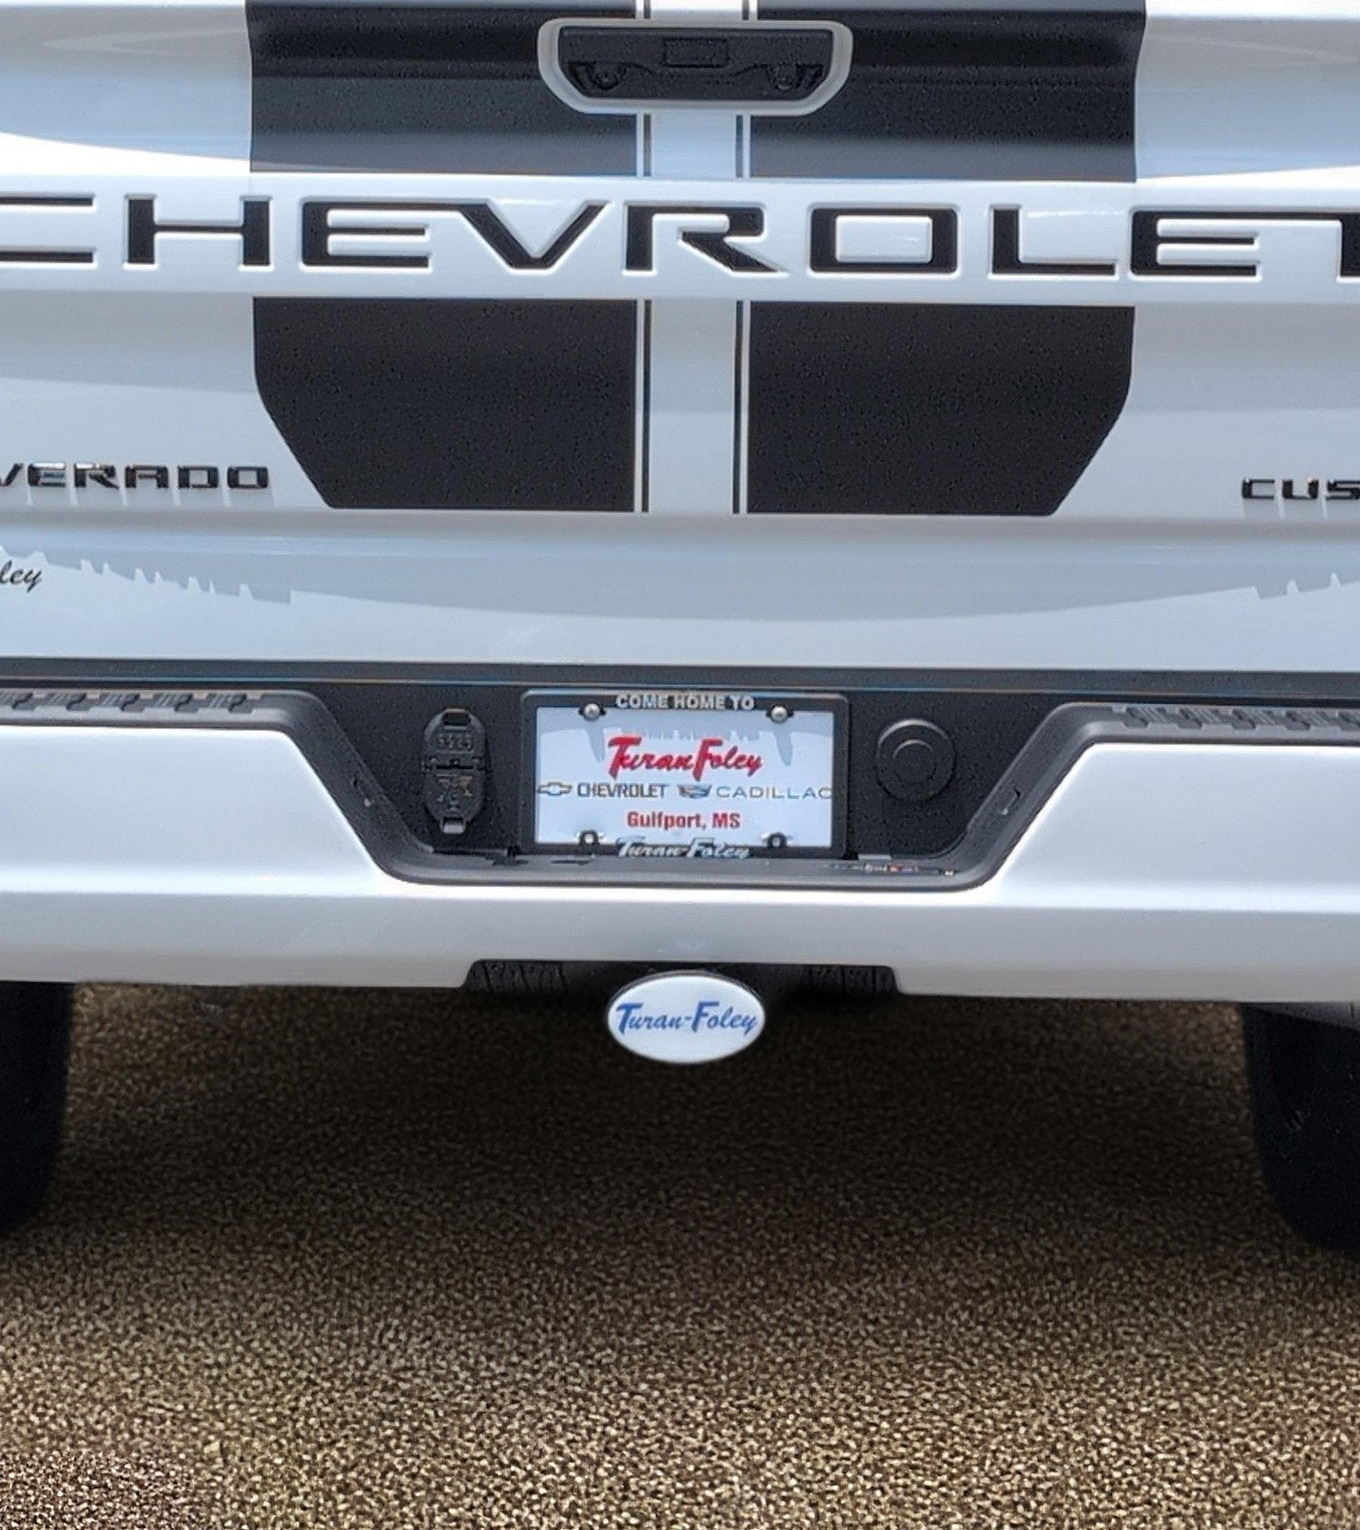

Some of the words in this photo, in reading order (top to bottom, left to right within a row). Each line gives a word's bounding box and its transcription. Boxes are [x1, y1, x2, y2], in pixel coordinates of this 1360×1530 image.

[615, 693, 669, 709] COME
[673, 694, 725, 710] HOME
[728, 695, 755, 711] TO
[576, 782, 667, 799] CHEVROLET
[716, 785, 833, 800] CADILLAC
[626, 811, 707, 830] Gulfport,
[712, 812, 741, 829] MS
[615, 1000, 757, 1036] Turan-Foley
